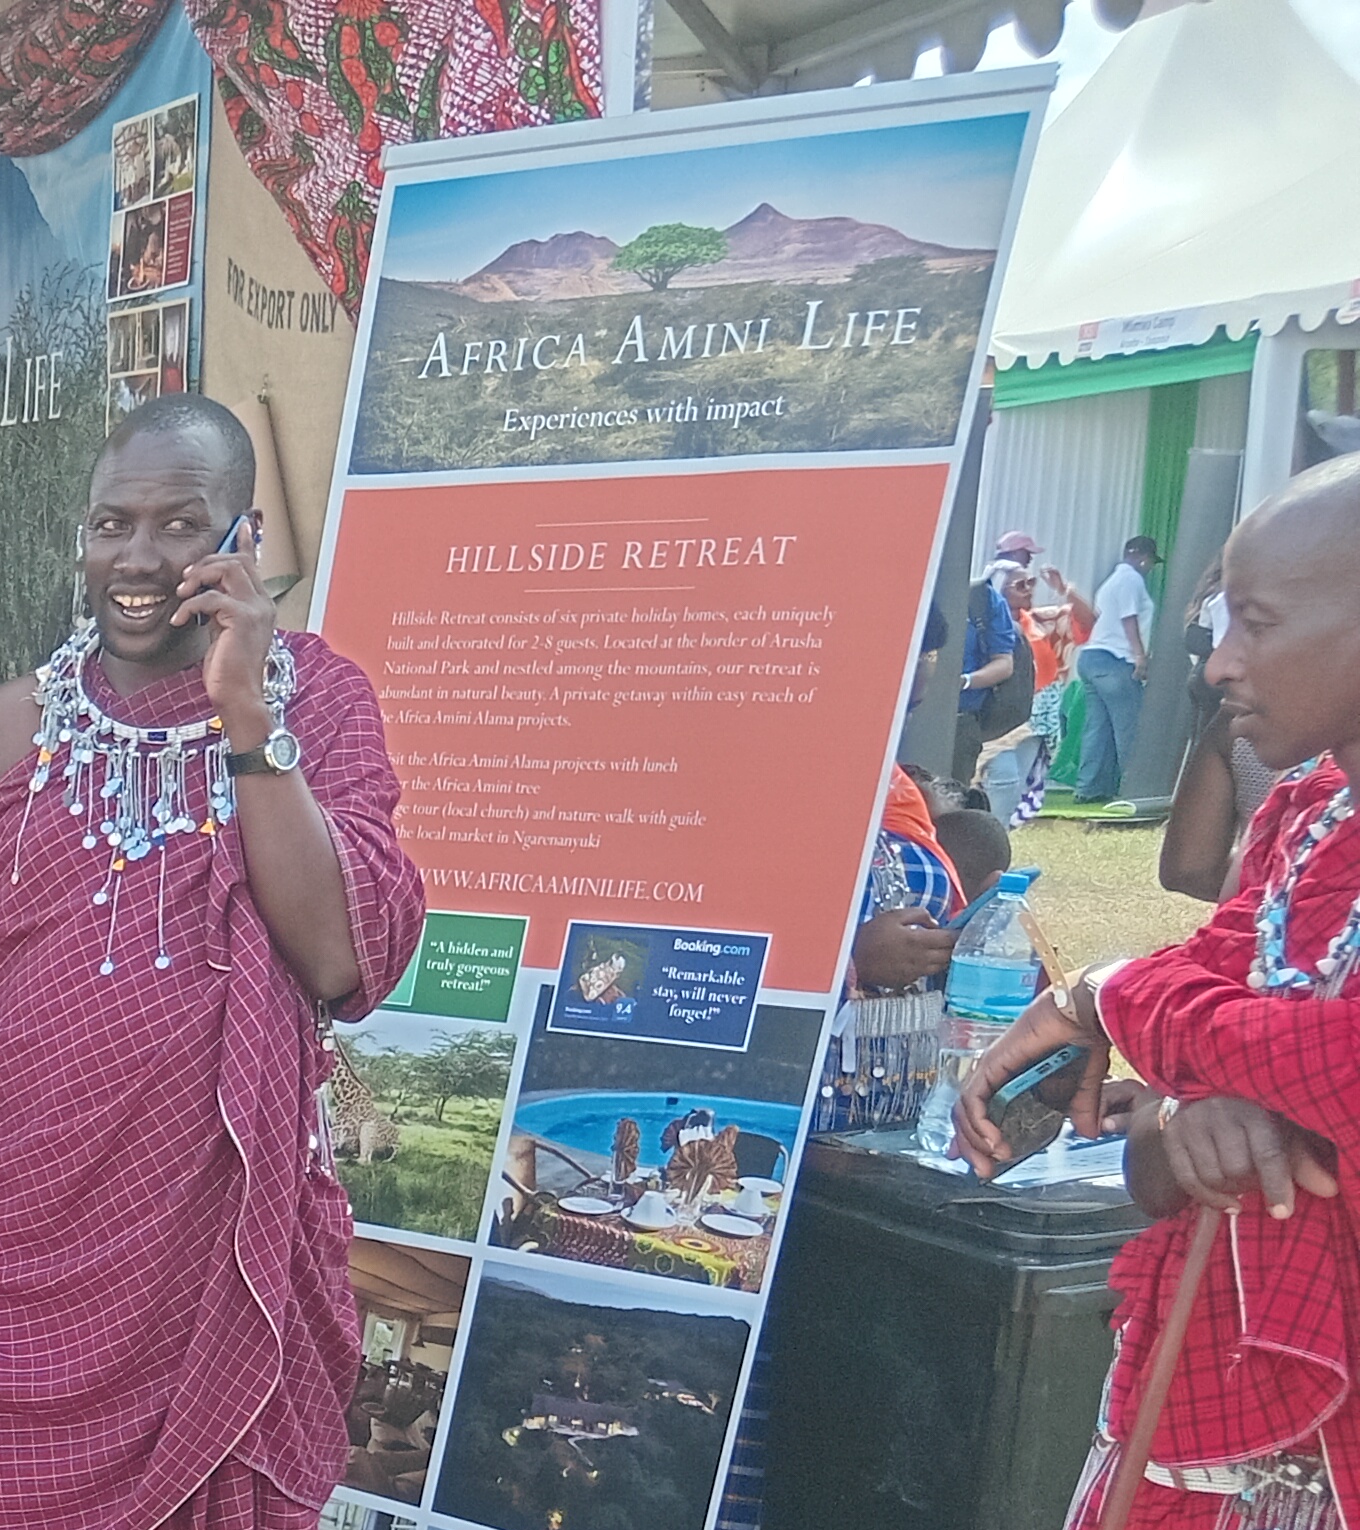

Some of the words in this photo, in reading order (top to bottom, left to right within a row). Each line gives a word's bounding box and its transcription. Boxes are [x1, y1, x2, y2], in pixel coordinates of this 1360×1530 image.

[227, 257, 245, 309] FOR
[247, 277, 296, 329] EXPORT
[299, 292, 339, 333] ONLY
[417, 332, 587, 380] AFRICA
[612, 314, 772, 365] AMINI
[797, 299, 923, 352] LIFE
[0, 335, 63, 427] LIFE
[502, 407, 638, 441] Experiences
[646, 397, 698, 425] with
[705, 394, 785, 429] impact
[445, 541, 608, 573] HILLSIDE
[622, 535, 798, 571] RETREAT
[391, 610, 437, 626] Hillside
[440, 610, 486, 625] Retreat
[489, 612, 540, 624] consists
[543, 609, 560, 624] of
[559, 612, 577, 623] six
[579, 609, 628, 629] private
[630, 607, 679, 629] holiday
[683, 606, 729, 623] homes,
[733, 605, 767, 621] each
[771, 605, 835, 628] uniquely
[387, 635, 414, 651] built
[416, 635, 440, 650] and
[441, 634, 505, 650] decorated
[507, 634, 528, 650] for
[530, 634, 553, 650] 2-8
[556, 636, 599, 655] guests.
[603, 634, 659, 650] Located
[660, 634, 673, 649] at
[676, 633, 697, 648] the
[700, 632, 748, 648] border
[751, 631, 771, 648] of
[770, 632, 822, 649] Arusha
[383, 660, 439, 676] National
[440, 660, 470, 675] Park
[473, 660, 499, 675] and
[503, 660, 554, 675] nestled
[556, 664, 603, 681] among
[607, 659, 631, 676] the
[635, 660, 712, 677] mountains,
[716, 662, 744, 675] our
[748, 662, 803, 676] retreat
[808, 661, 820, 675] is
[378, 685, 433, 700] abundant
[437, 686, 448, 699] in
[452, 685, 498, 700] natural
[501, 685, 545, 706] beauty.
[549, 686, 560, 700] A
[562, 687, 610, 706] private
[612, 689, 666, 707] getaway
[672, 686, 713, 702] within
[717, 690, 747, 708] easy
[751, 687, 794, 703] reach
[798, 687, 818, 703] of
[397, 709, 430, 724] Africa
[433, 709, 471, 725] Amini
[473, 711, 514, 725] Alama
[516, 712, 571, 730] projects.
[388, 752, 404, 766] isit
[408, 752, 427, 767] the
[429, 752, 466, 768] Africa
[468, 753, 508, 769] Amini
[510, 755, 550, 770] Alama
[552, 757, 606, 775] projects
[610, 756, 640, 772] with
[642, 757, 678, 773] lunch
[411, 777, 430, 791] the
[432, 777, 470, 793] Africa
[472, 779, 512, 794] Amini
[515, 781, 540, 795] tree
[412, 801, 440, 816] tour
[442, 801, 477, 819] (local
[480, 804, 530, 822] church)
[532, 807, 555, 822] and
[558, 809, 601, 823] nature
[604, 808, 634, 825] walk
[638, 809, 667, 825] with
[669, 811, 707, 831] guide
[416, 826, 445, 841] local
[448, 828, 494, 843] market
[497, 829, 508, 844] in
[512, 831, 602, 853] Ngarenanyuki
[448, 941, 489, 958] hidden
[490, 946, 514, 959] and
[673, 938, 750, 956] Booking.com
[426, 958, 455, 976] truly
[457, 964, 510, 979] gorgeous
[652, 985, 679, 1004] stay,
[681, 986, 707, 1001] will
[708, 992, 747, 1005] never
